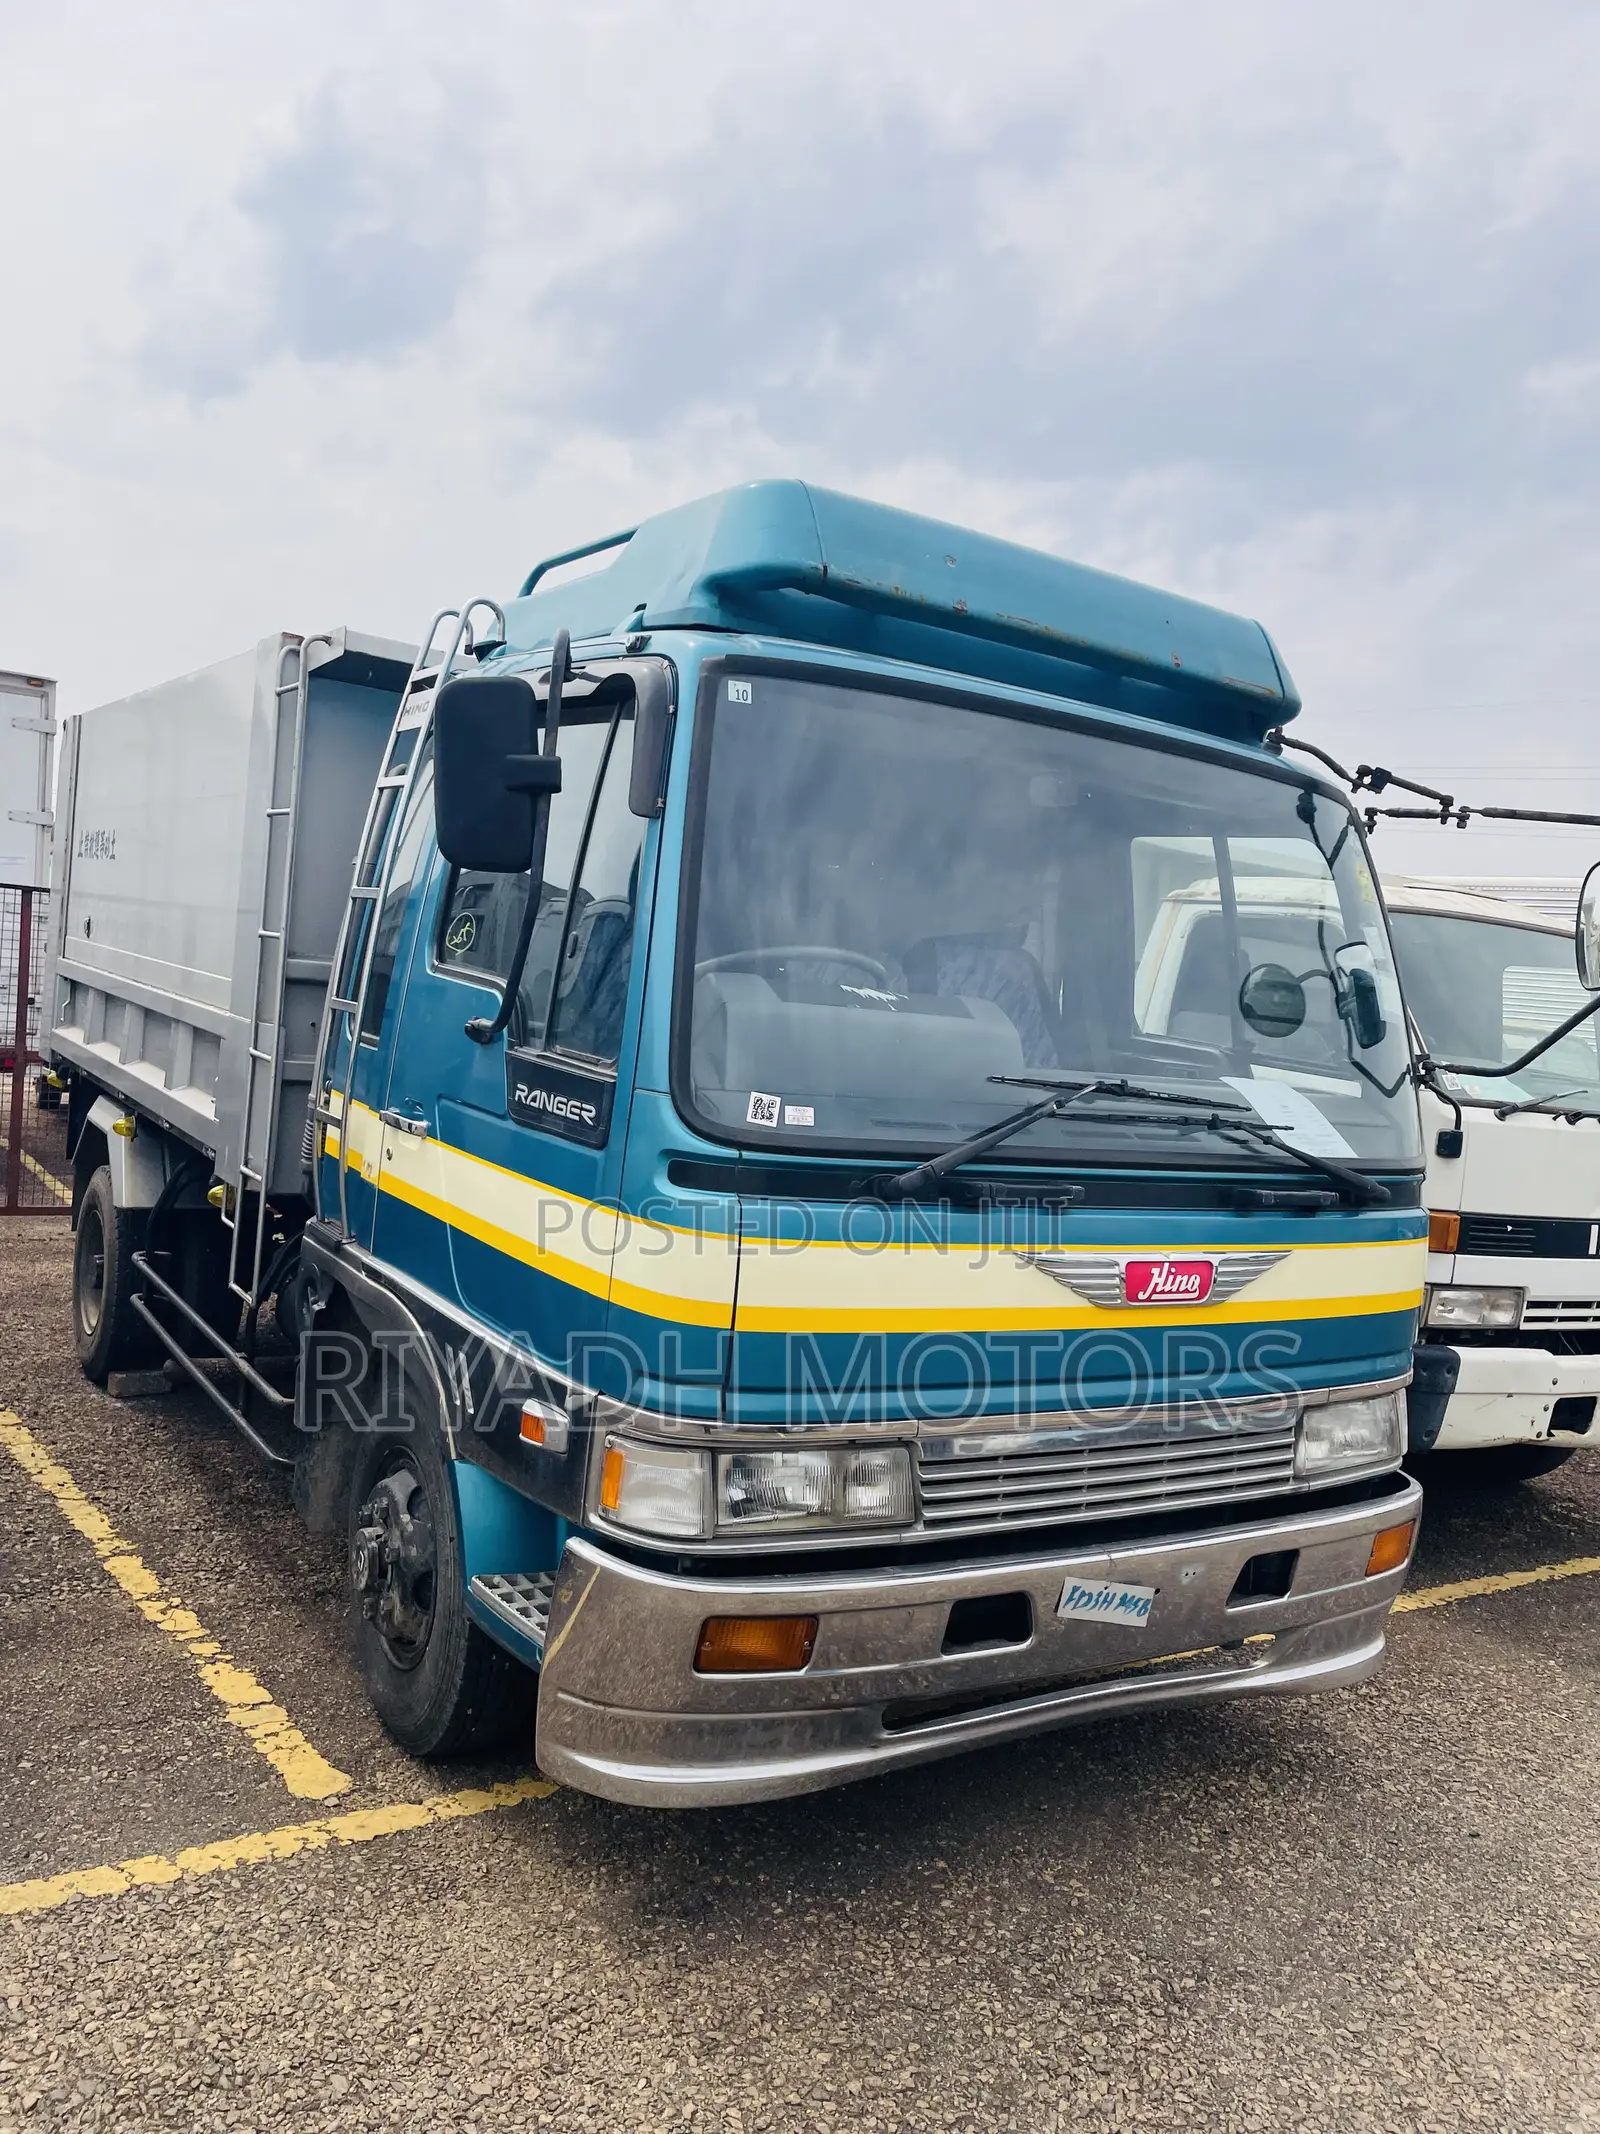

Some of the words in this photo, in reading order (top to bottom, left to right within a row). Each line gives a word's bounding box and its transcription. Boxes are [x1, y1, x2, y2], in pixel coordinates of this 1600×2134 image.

[403, 700, 431, 718] HINO
[735, 688, 749, 702] 10
[514, 1083, 597, 1127] RANGER
[1137, 1262, 1201, 1301] Hino
